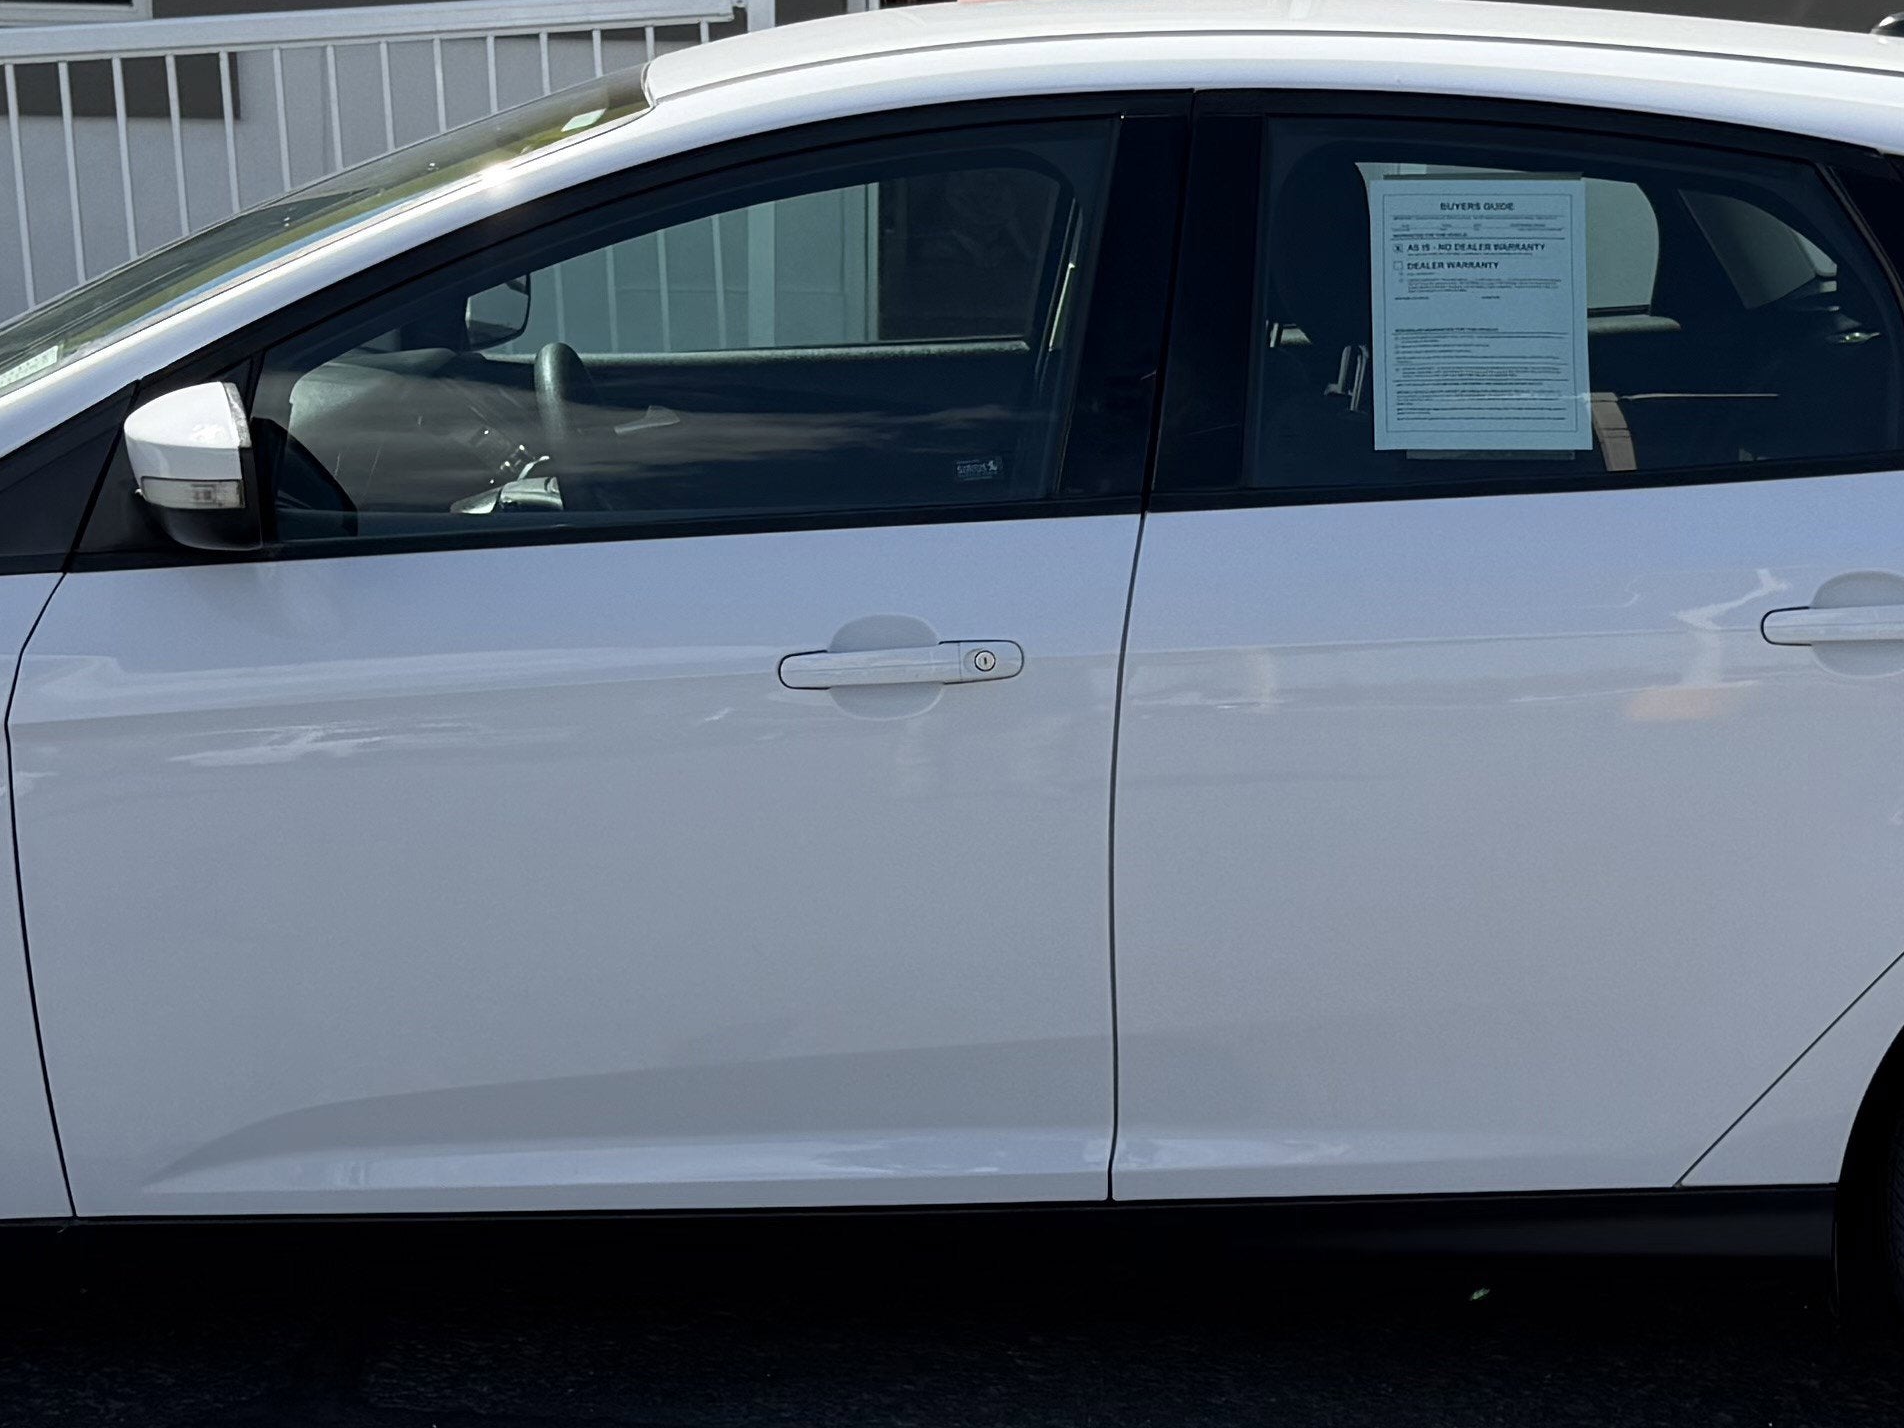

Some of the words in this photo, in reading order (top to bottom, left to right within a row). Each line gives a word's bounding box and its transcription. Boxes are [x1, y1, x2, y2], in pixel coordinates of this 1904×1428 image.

[1439, 201, 1481, 211] BUYERS
[1483, 201, 1515, 211] GUIDE
[1407, 243, 1420, 252] AS
[1454, 243, 1492, 252] DEALER
[1493, 243, 1546, 252] WARRANTY
[1406, 261, 1445, 270] DEALER
[1447, 261, 1500, 270] WARRANTY
